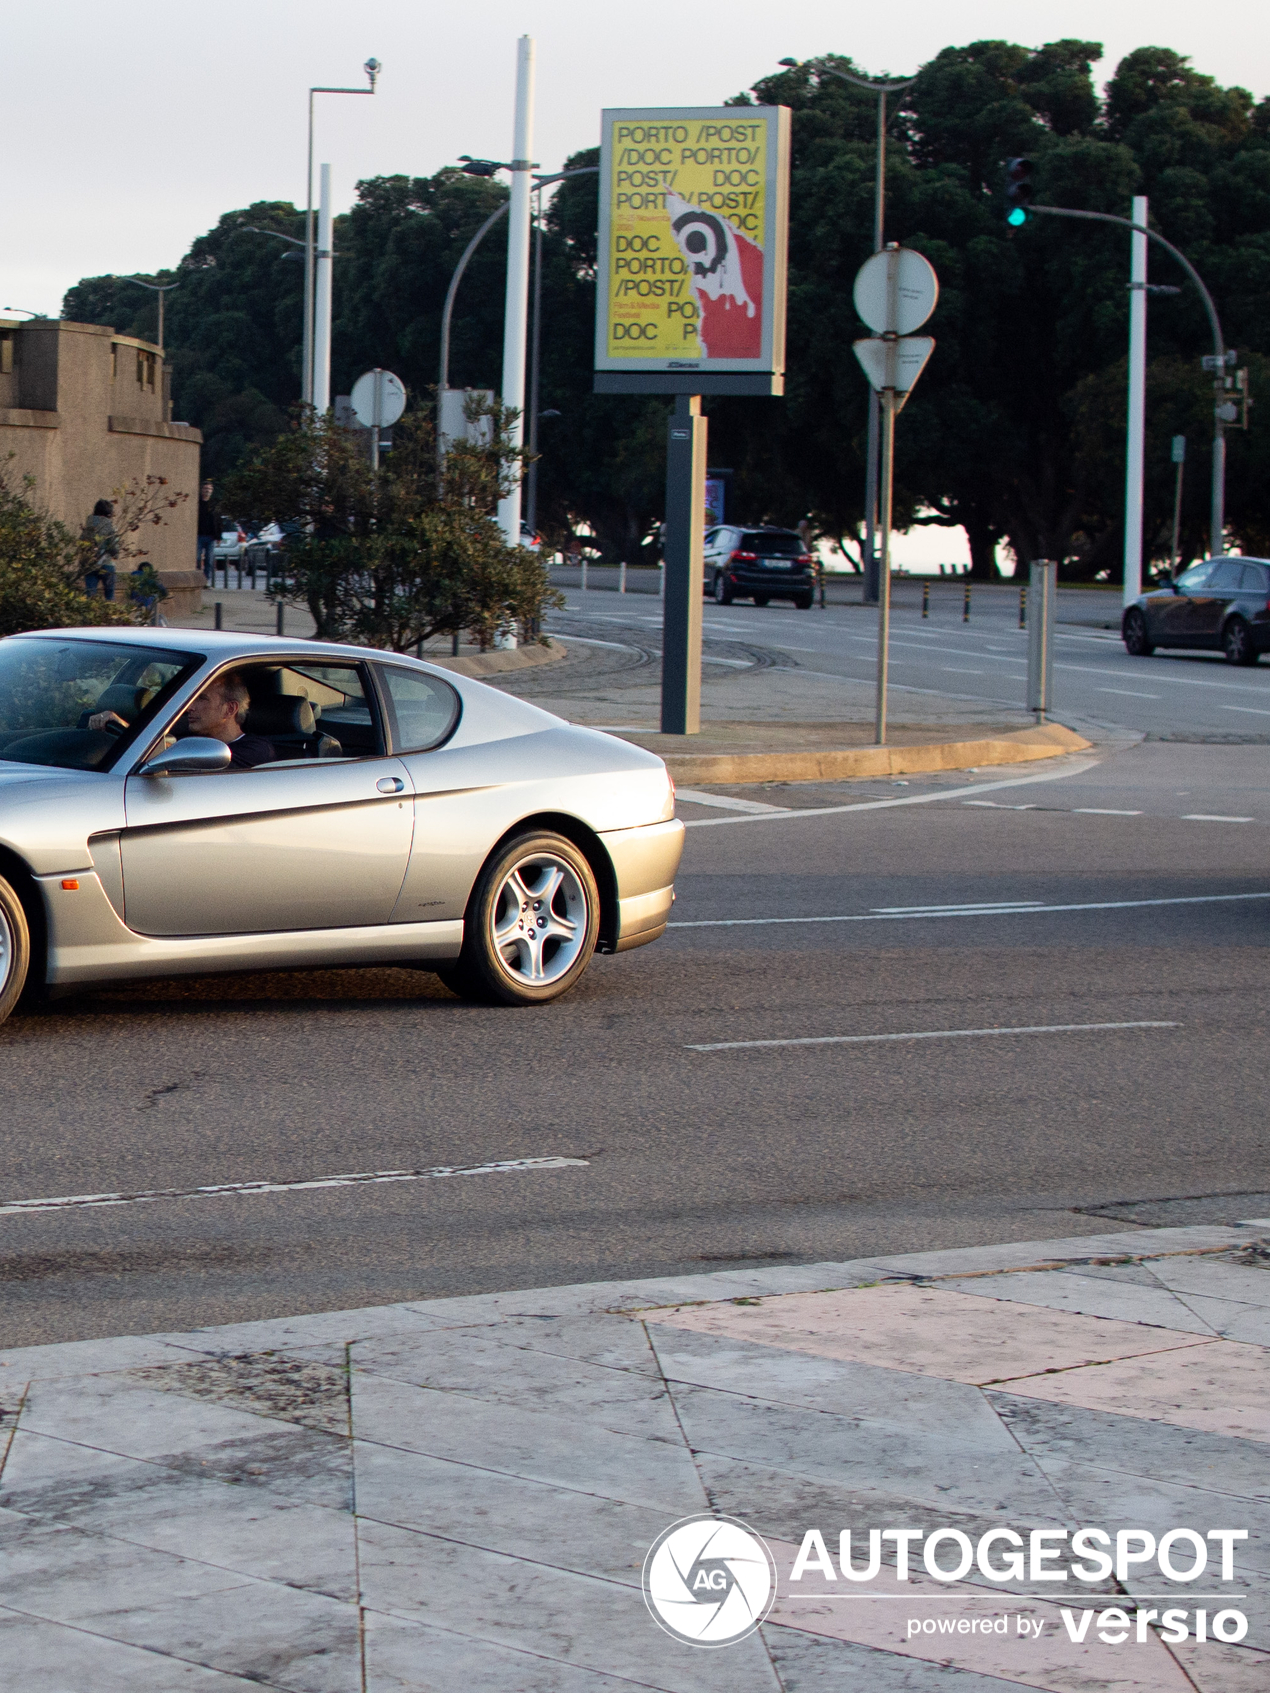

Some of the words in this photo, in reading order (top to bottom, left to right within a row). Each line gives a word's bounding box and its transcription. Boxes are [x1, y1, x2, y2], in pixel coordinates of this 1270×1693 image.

[618, 126, 688, 143] PORTO
[696, 125, 761, 143] /POST
[618, 148, 673, 166] /DOC
[681, 147, 759, 164] PORTO/
[617, 170, 678, 187] POST/
[713, 169, 759, 187] DOC
[697, 192, 759, 209] POST/
[616, 235, 661, 253] DOC
[615, 279, 684, 297] /POST/
[613, 322, 658, 340] DOC
